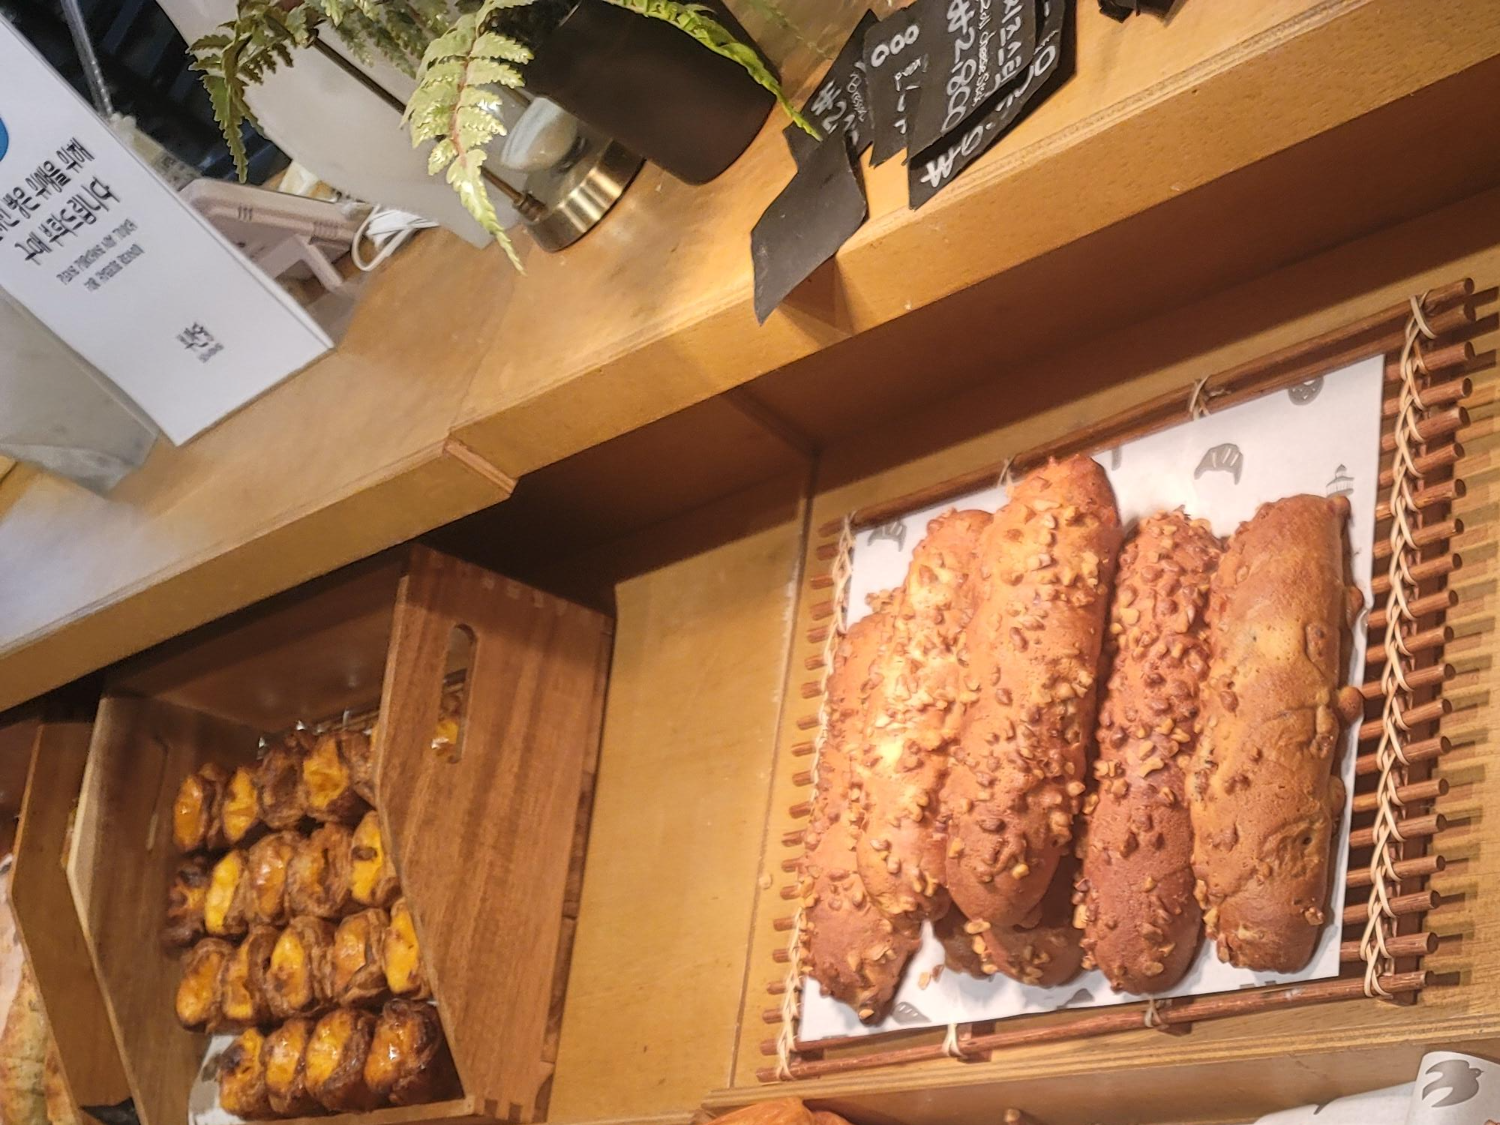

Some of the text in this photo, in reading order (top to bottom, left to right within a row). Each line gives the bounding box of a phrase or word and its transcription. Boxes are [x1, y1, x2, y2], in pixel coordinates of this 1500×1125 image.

[25, 160, 72, 201] 위생을
[56, 137, 95, 174] 위해
[14, 231, 53, 266] 구매
[38, 176, 121, 248] 부탁드립니다
